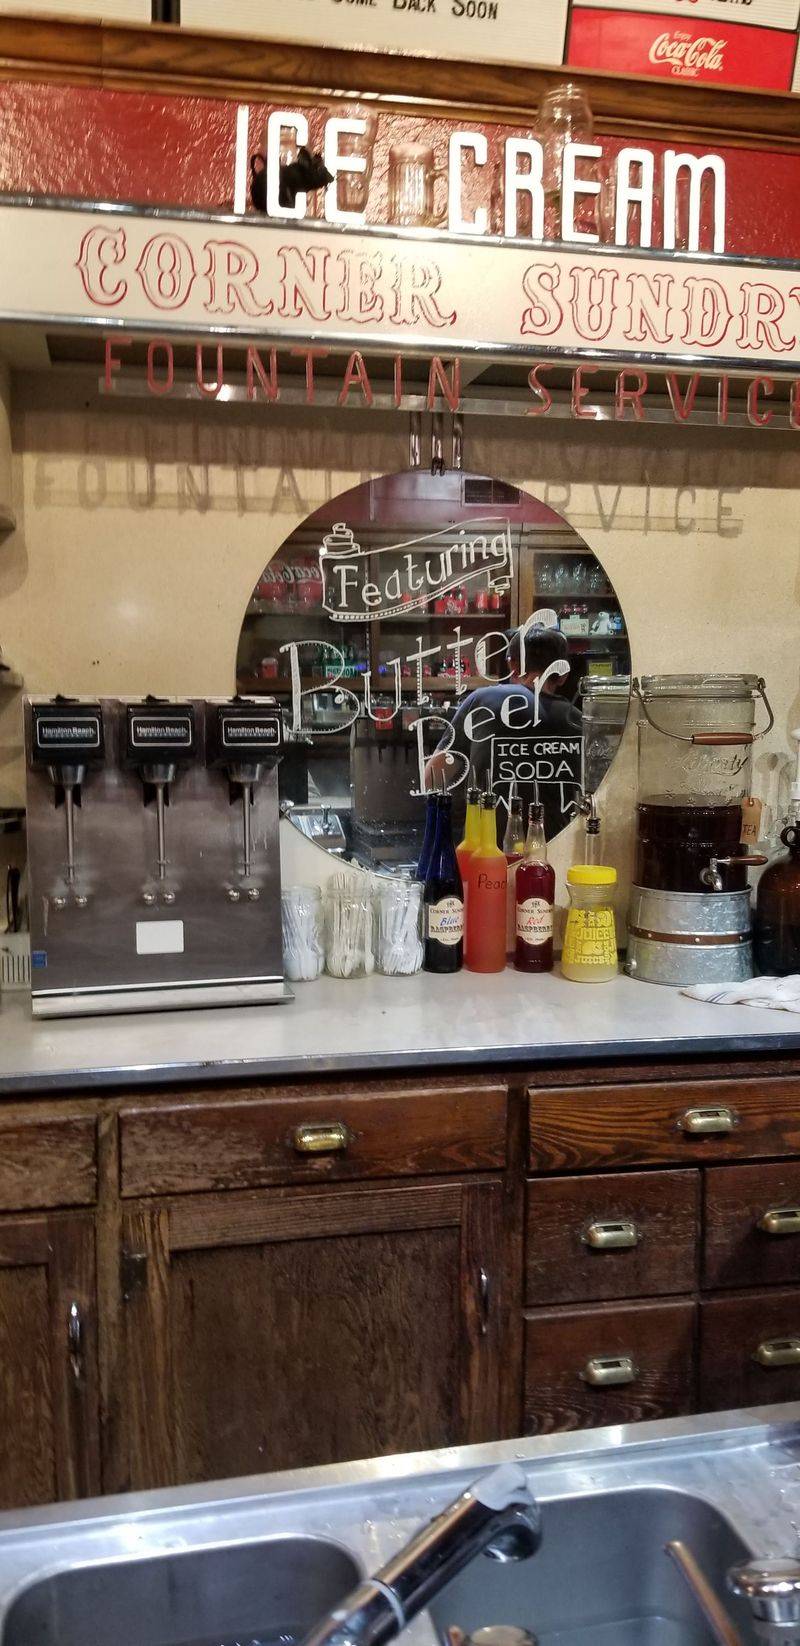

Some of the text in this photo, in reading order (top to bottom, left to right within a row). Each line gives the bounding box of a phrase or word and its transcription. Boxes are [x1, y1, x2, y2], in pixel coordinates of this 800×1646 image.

[451, 0, 498, 20] SOON
[233, 104, 727, 254] ICE CREAM
[74, 223, 800, 353] CORNER SUNDR
[102, 334, 462, 413] FOUNTAIN
[331, 530, 509, 608] Featuring
[279, 608, 559, 735] Butter
[408, 658, 572, 797] Beer
[497, 743, 530, 757] ICE
[533, 741, 580, 756] CREAM
[499, 760, 575, 780] SODA
[743, 823, 757, 837] TEA
